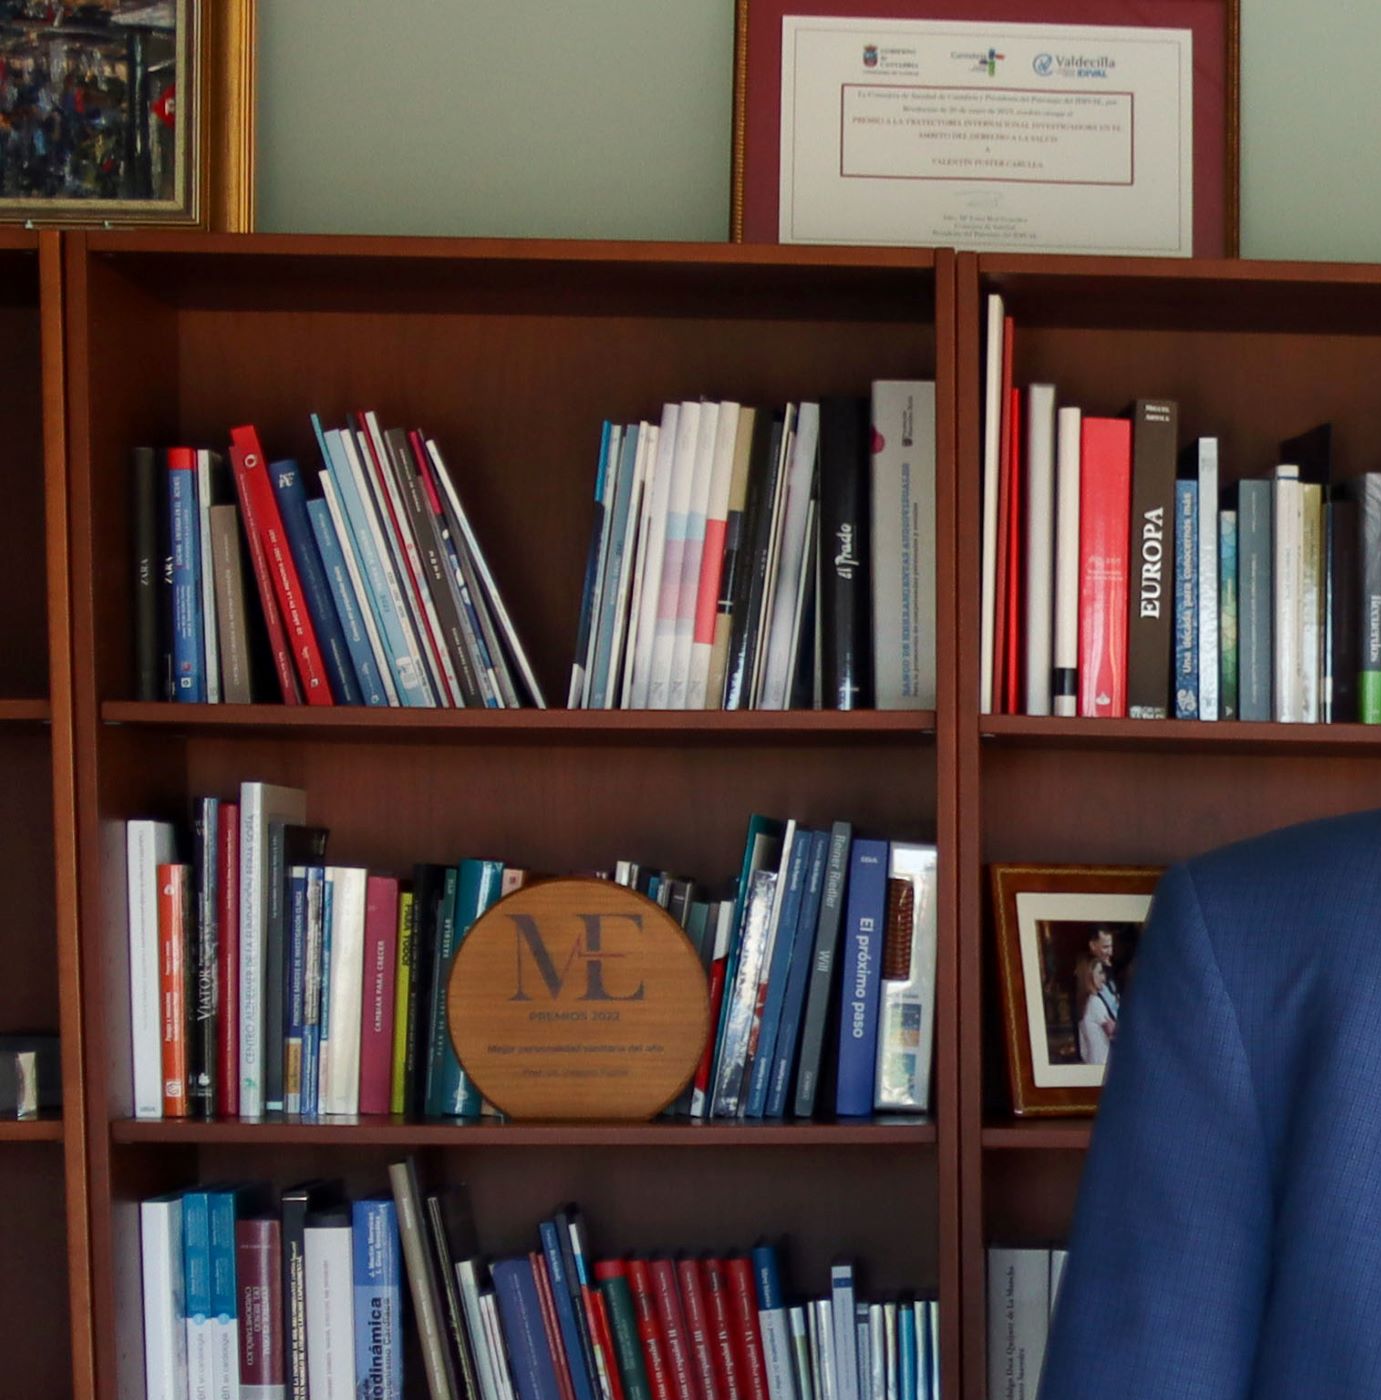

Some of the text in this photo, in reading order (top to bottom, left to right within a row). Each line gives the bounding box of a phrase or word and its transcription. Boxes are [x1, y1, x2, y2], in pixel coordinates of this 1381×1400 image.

[1054, 53, 1117, 70] Valdecilla
[833, 522, 860, 579] El Prado
[1139, 506, 1165, 620] EUROPA
[1181, 492, 1194, 673] Una década para conocernos más
[1369, 594, 1381, 662] Recuerdos
[901, 641, 910, 657] DE
[816, 833, 846, 972] Reiner Riedler Will
[372, 939, 386, 1032] CAMBIAR PARA CRECER
[848, 917, 874, 1038] El próximo paso
[196, 969, 212, 1021] VIATOR
[528, 1010, 620, 1022] PREMIOS 2022
[647, 1337, 662, 1371] español
[669, 1338, 684, 1372] español
[696, 1342, 710, 1377] español
[720, 1341, 734, 1375] español
[747, 1342, 760, 1376] español
[654, 1371, 663, 1383] en
[676, 1371, 686, 1383] en
[703, 1376, 712, 1388] en
[726, 1375, 735, 1387] en
[752, 1376, 761, 1388] en
